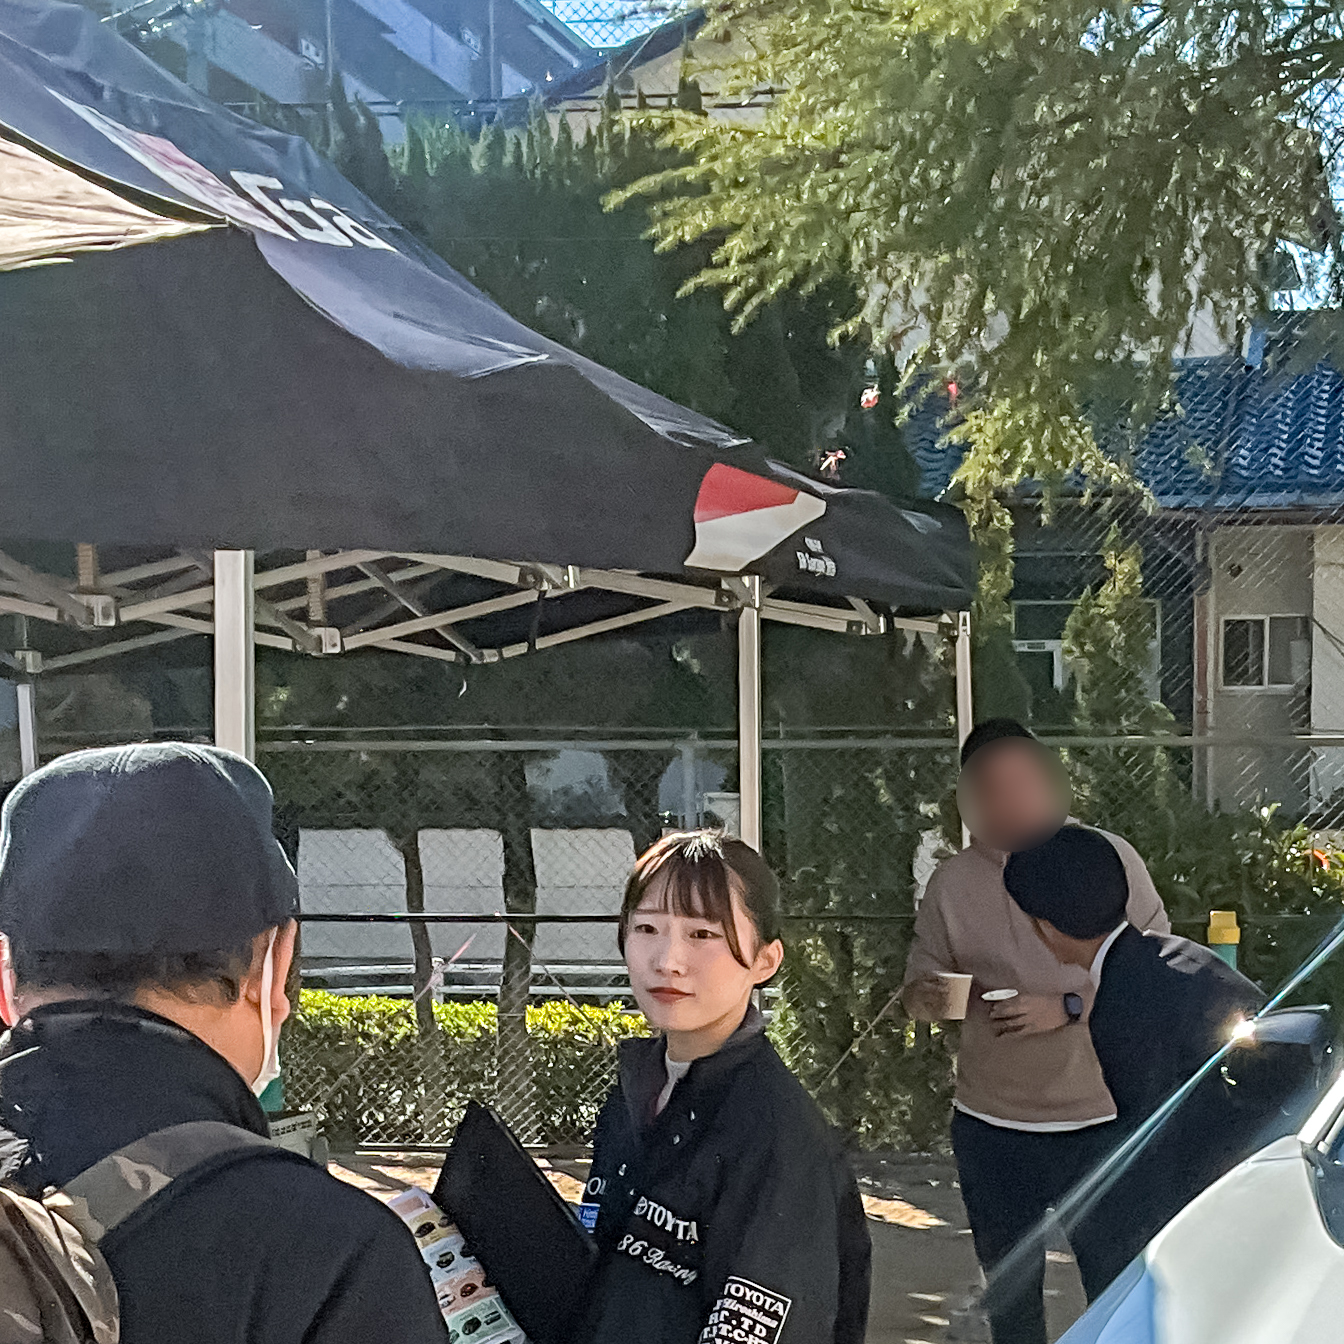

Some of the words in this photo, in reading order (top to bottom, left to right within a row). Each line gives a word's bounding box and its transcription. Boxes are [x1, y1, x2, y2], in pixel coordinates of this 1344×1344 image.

[647, 1200, 699, 1241] TOYTA
[617, 1234, 649, 1256] 86
[723, 1282, 785, 1316] TOYOTA
